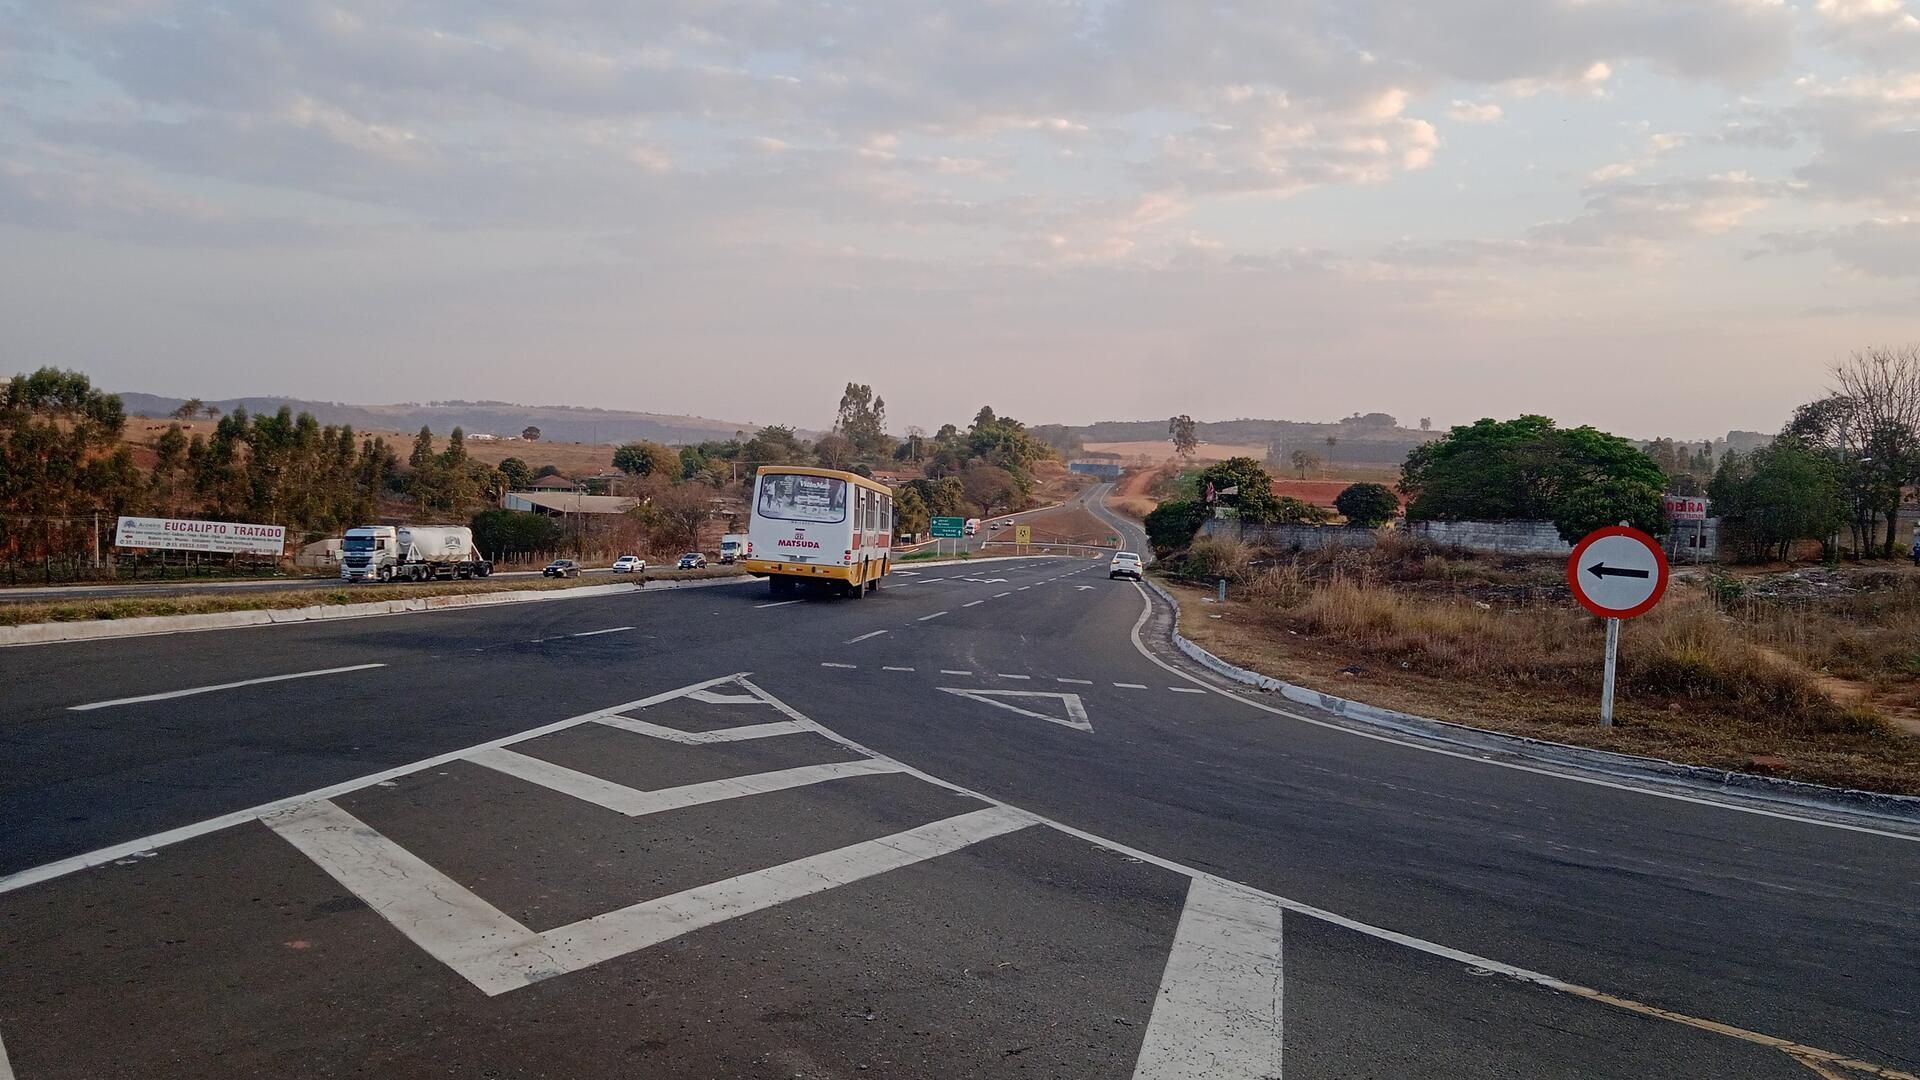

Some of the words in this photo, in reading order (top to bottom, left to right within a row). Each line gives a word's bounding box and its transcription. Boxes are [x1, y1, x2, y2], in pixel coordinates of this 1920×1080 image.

[164, 521, 227, 534] EUCALIPTO
[233, 526, 282, 538] TRATADO
[778, 539, 820, 549] MATSUDA
